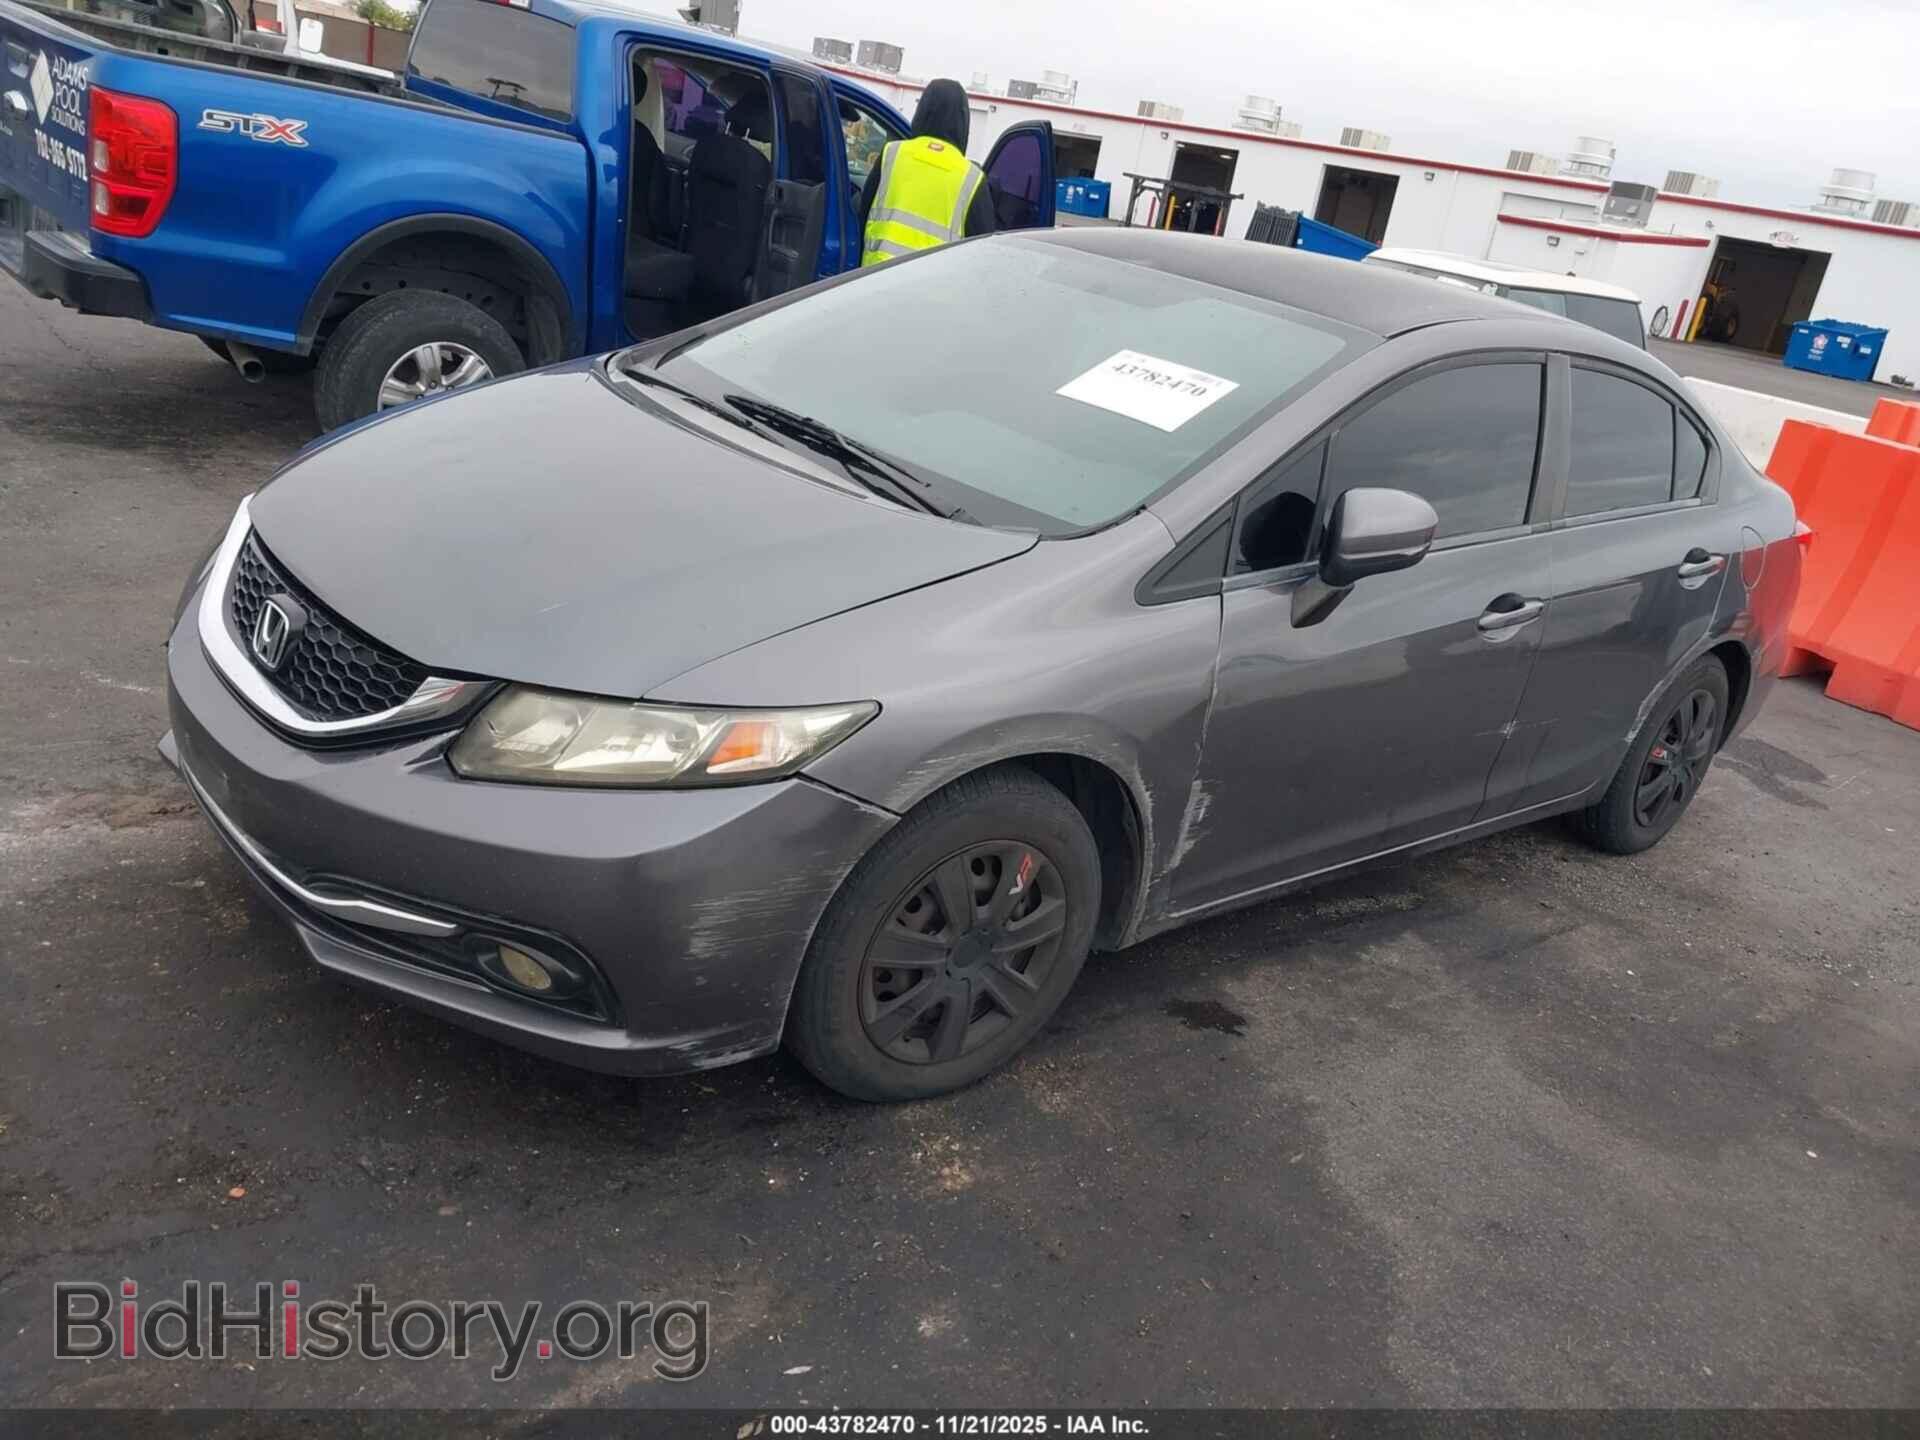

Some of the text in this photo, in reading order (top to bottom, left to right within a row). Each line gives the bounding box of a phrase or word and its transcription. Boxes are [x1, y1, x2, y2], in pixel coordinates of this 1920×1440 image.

[51, 56, 88, 91] ADAMS
[55, 82, 82, 117] POOL
[51, 105, 86, 136] SOLUTIONS
[196, 108, 309, 147] STX
[1111, 363, 1208, 397] 43782470
